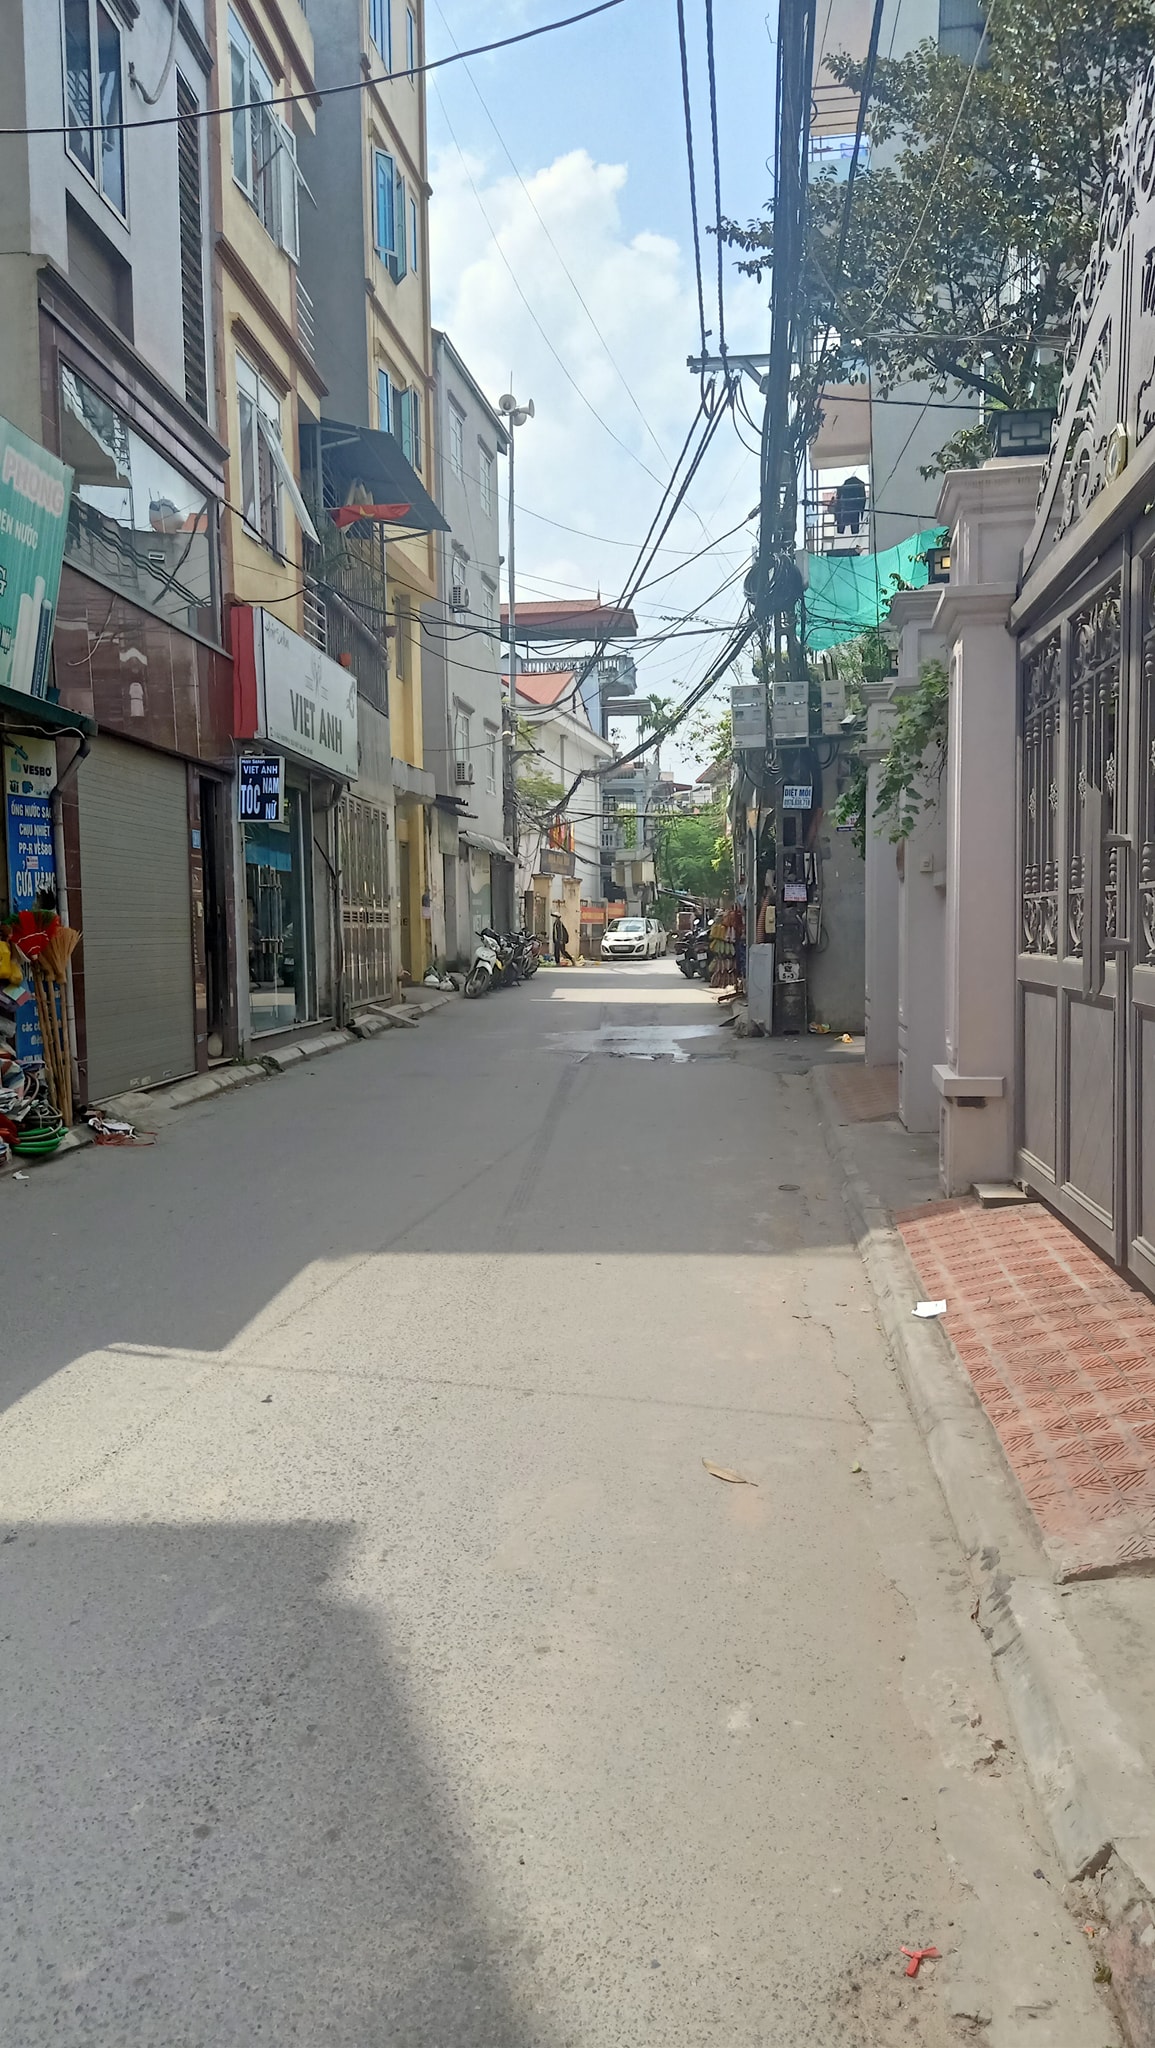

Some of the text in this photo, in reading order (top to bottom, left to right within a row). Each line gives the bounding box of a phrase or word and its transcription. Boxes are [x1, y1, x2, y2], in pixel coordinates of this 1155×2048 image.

[2, 444, 65, 518] PHONG
[289, 688, 315, 741] VIET
[319, 708, 343, 755] ANH
[23, 763, 52, 777] VESBO
[243, 765, 278, 774] VIET ANH
[262, 777, 280, 793] NAM
[240, 778, 261, 814] TÓC
[11, 799, 24, 816] ỐNG
[24, 803, 41, 818] NƯỚC
[265, 799, 277, 819] NỮ
[18, 842, 34, 855] PP-R
[16, 861, 34, 897] CỬA
